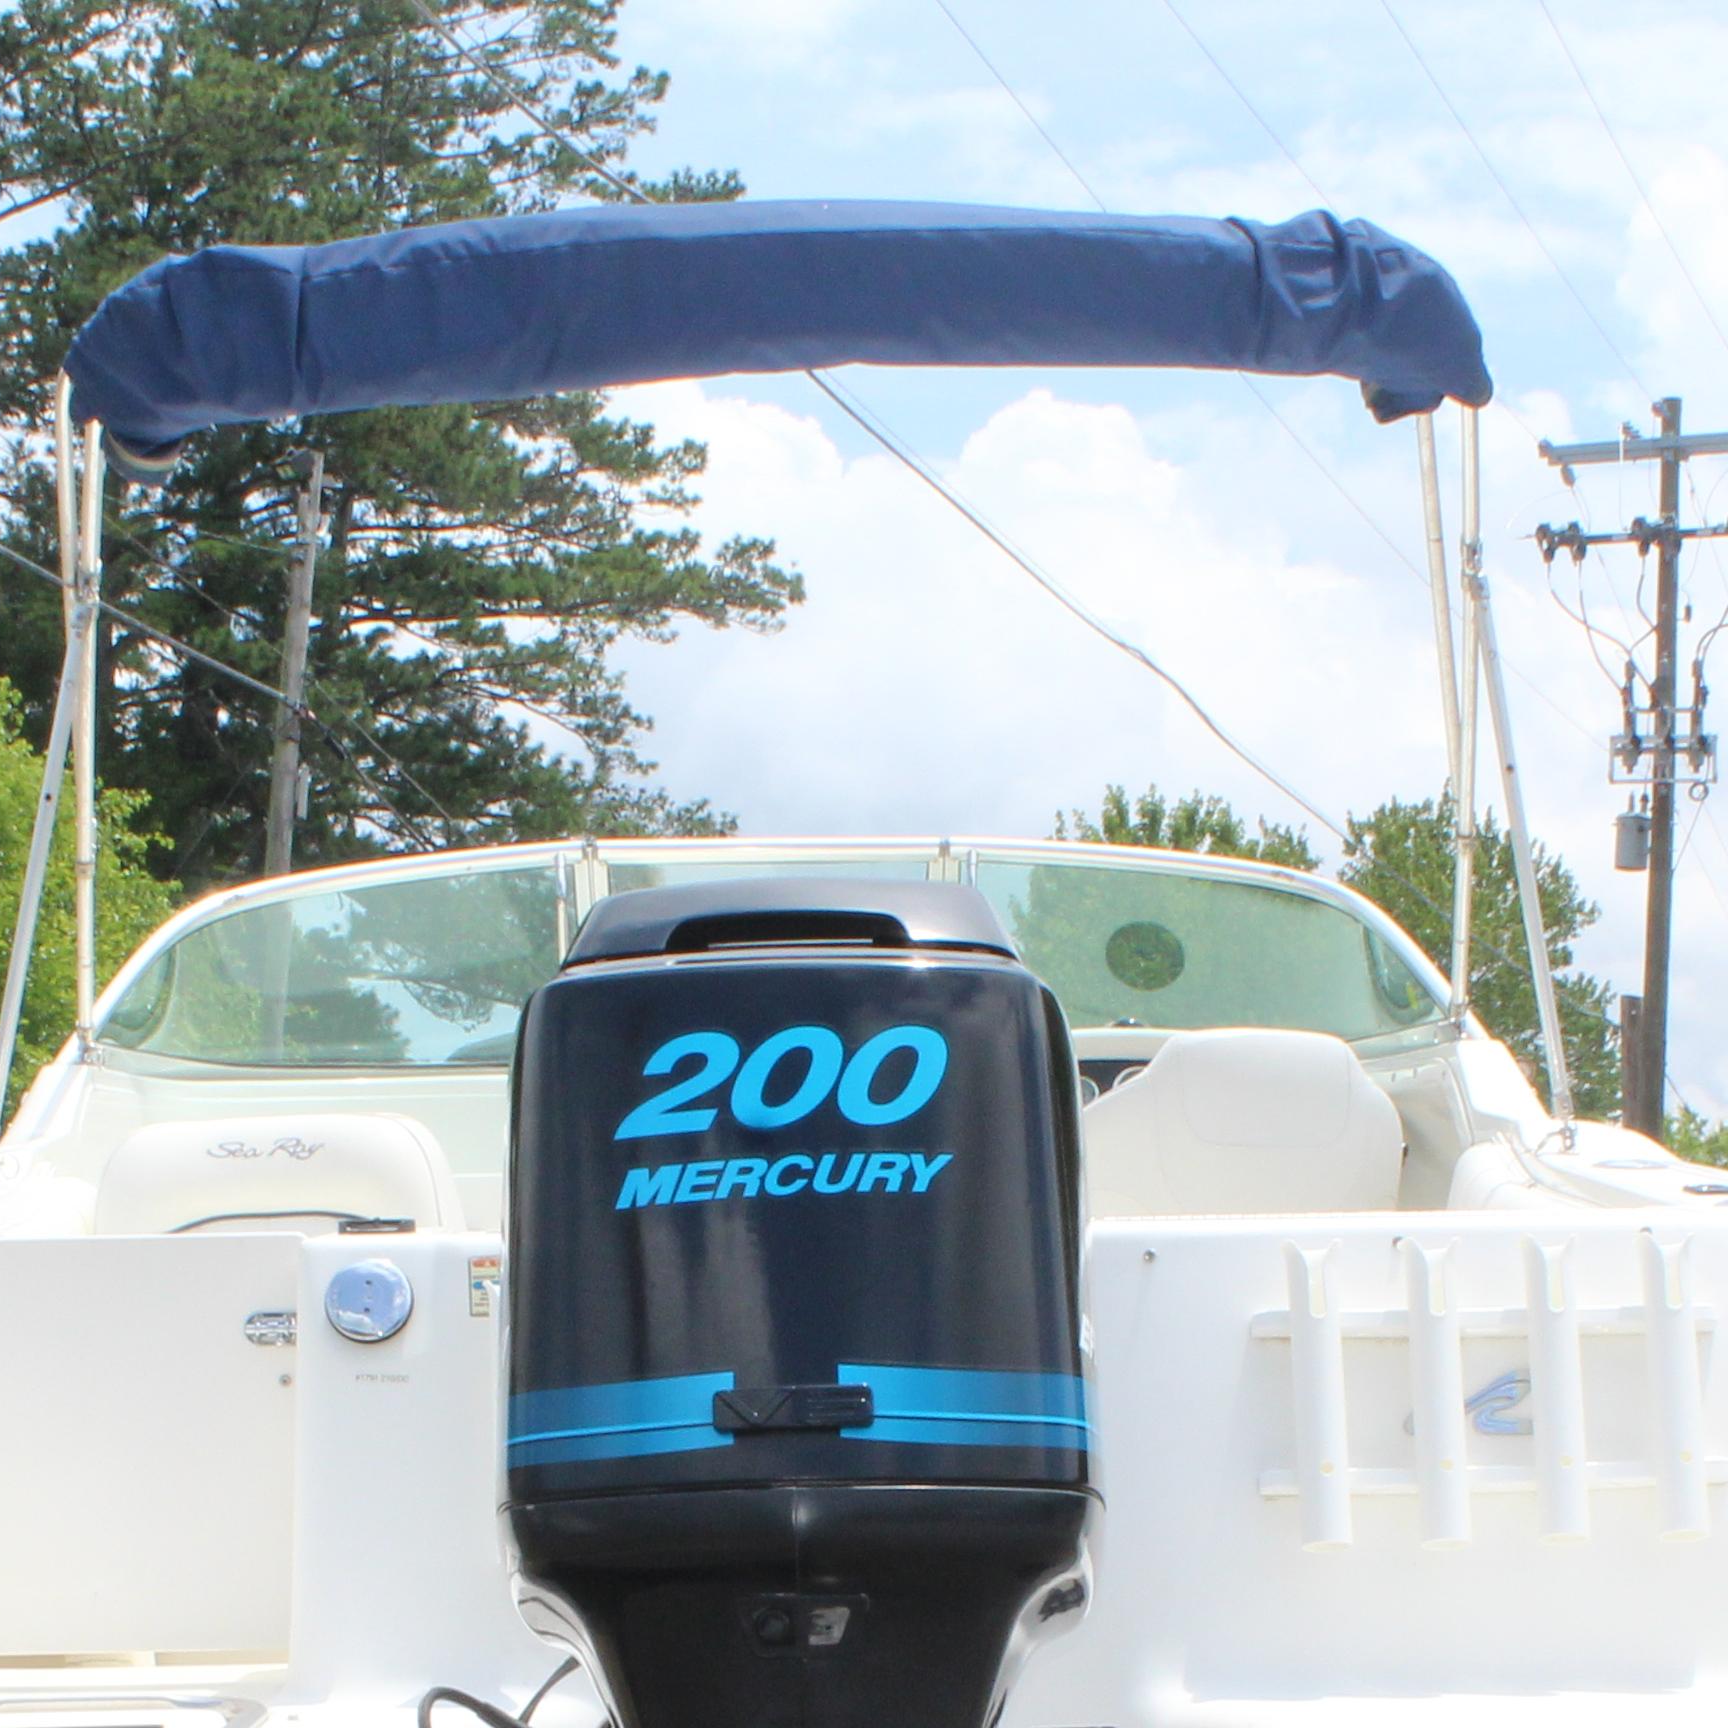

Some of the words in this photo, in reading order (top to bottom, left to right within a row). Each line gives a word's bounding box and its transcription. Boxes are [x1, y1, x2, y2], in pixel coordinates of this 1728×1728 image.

[612, 1024, 950, 1142] 200
[206, 1141, 263, 1159] Sea
[268, 1137, 325, 1161] Ray
[613, 1152, 954, 1211] MERCURY
